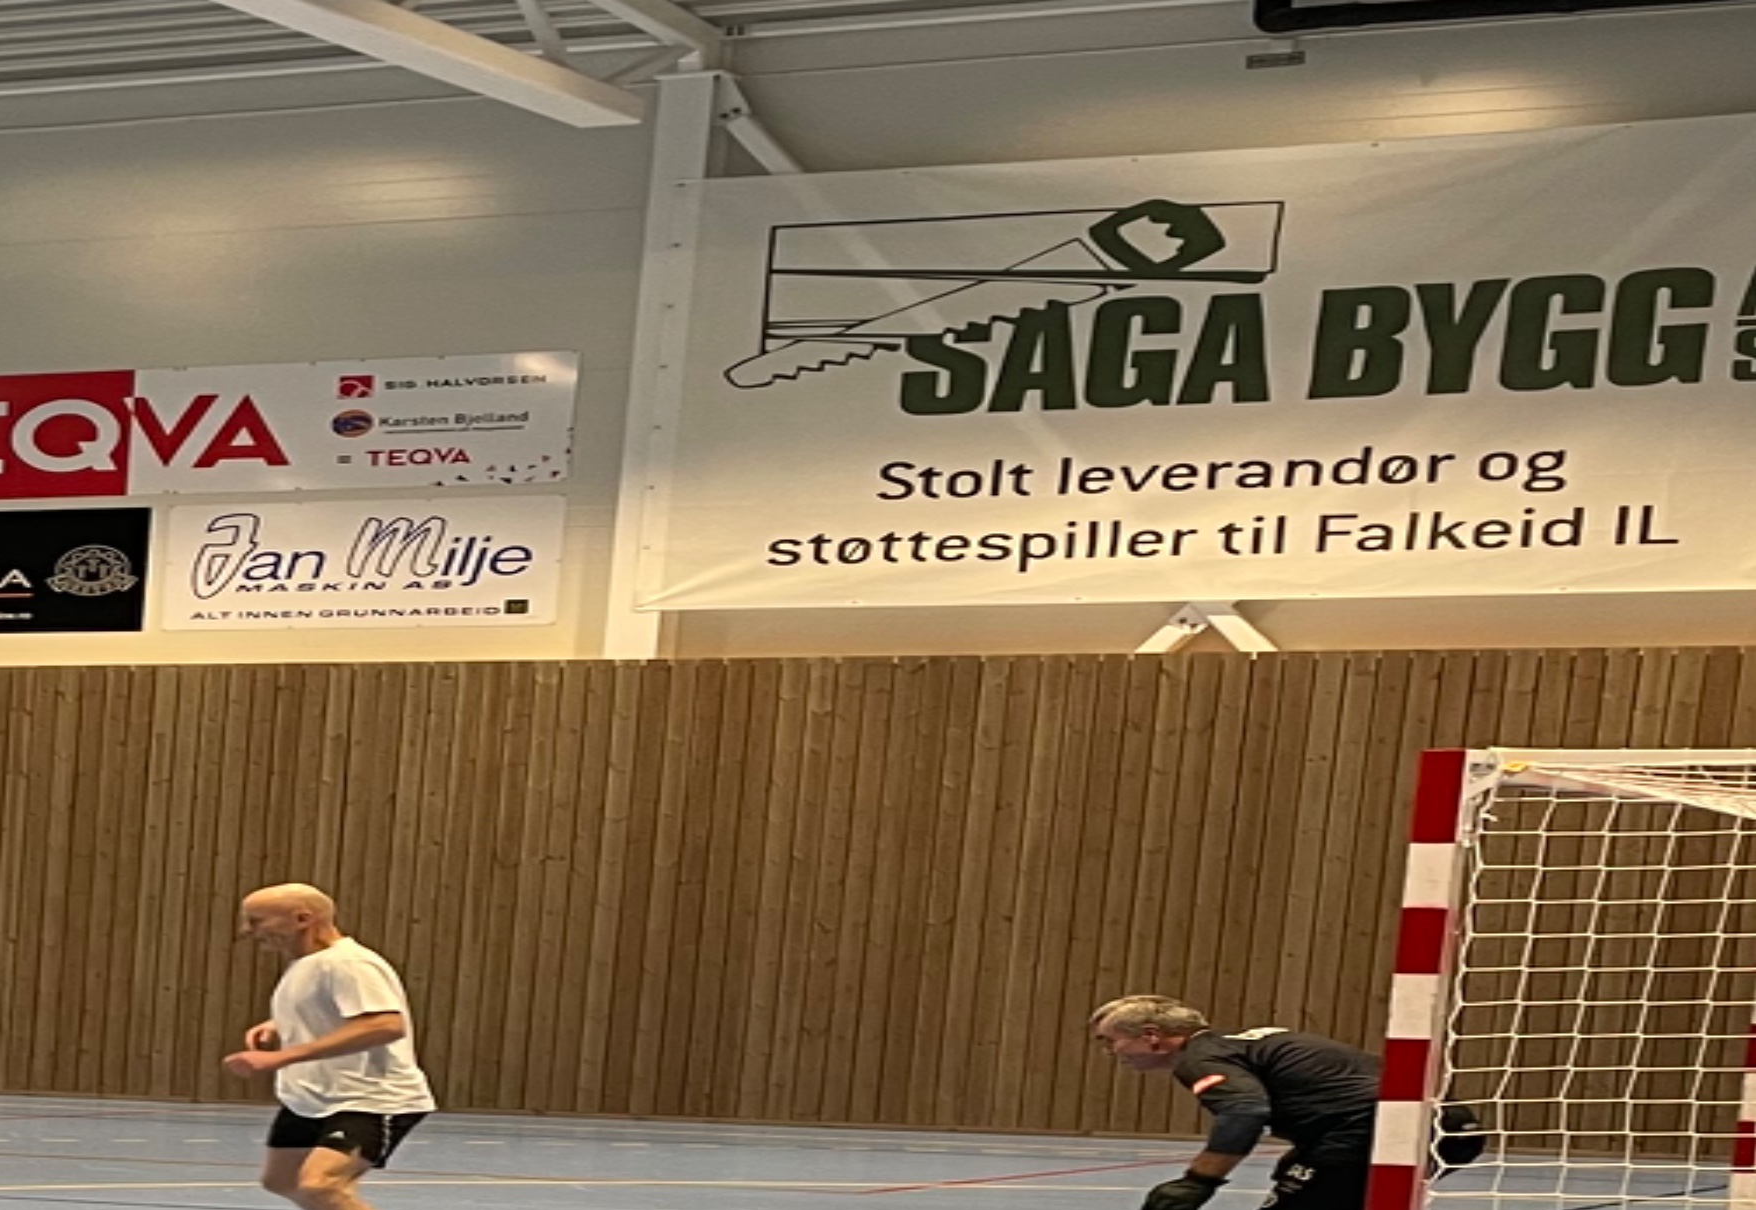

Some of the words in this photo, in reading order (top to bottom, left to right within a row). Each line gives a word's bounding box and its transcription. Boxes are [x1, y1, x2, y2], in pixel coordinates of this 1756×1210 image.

[898, 292, 1271, 417] SAGA
[1307, 266, 1717, 402] BYGG
[425, 375, 547, 388] HALVORSEN
[379, 415, 449, 428] Karsten
[454, 411, 529, 427] Bjelland
[365, 447, 471, 467] TEQVA
[874, 459, 1033, 502] Stolt
[1056, 446, 1456, 499] leverandør
[1476, 446, 1568, 493] og
[766, 517, 1201, 573] støttespiller
[1217, 513, 1287, 556] til
[1315, 505, 1586, 554] Falkeid
[1612, 503, 1680, 546] IL
[190, 512, 327, 601] Jan
[345, 515, 534, 587] Milje
[235, 581, 388, 593] MASKIN
[403, 579, 454, 590] AS
[189, 610, 233, 621] ALT
[237, 609, 313, 620] INNEN
[319, 606, 502, 620] GRUNNARBEID
